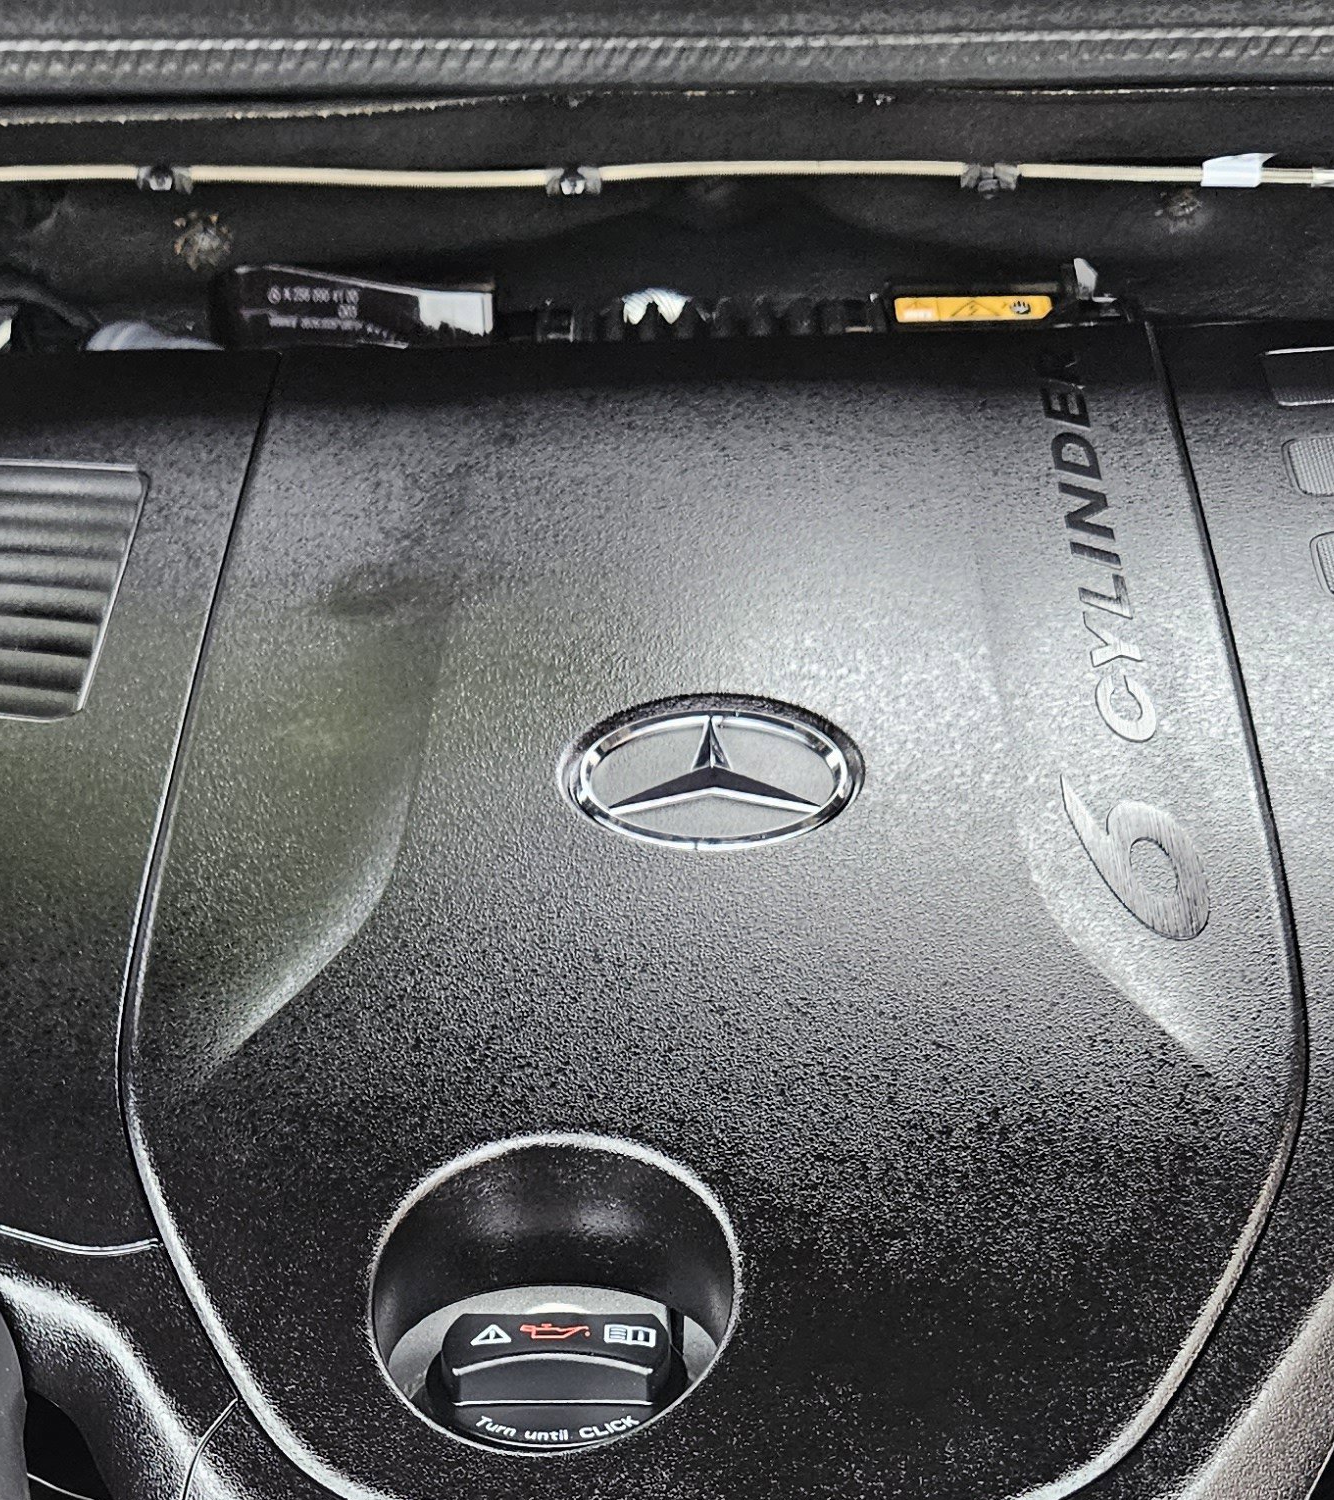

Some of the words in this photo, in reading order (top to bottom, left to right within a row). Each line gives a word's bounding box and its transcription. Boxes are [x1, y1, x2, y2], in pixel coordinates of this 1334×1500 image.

[1035, 353, 1157, 743] CYLINDE
[1059, 773, 1211, 942] 6
[475, 1415, 517, 1437] Turn
[524, 1429, 569, 1441] until
[578, 1415, 640, 1439] CLICK
